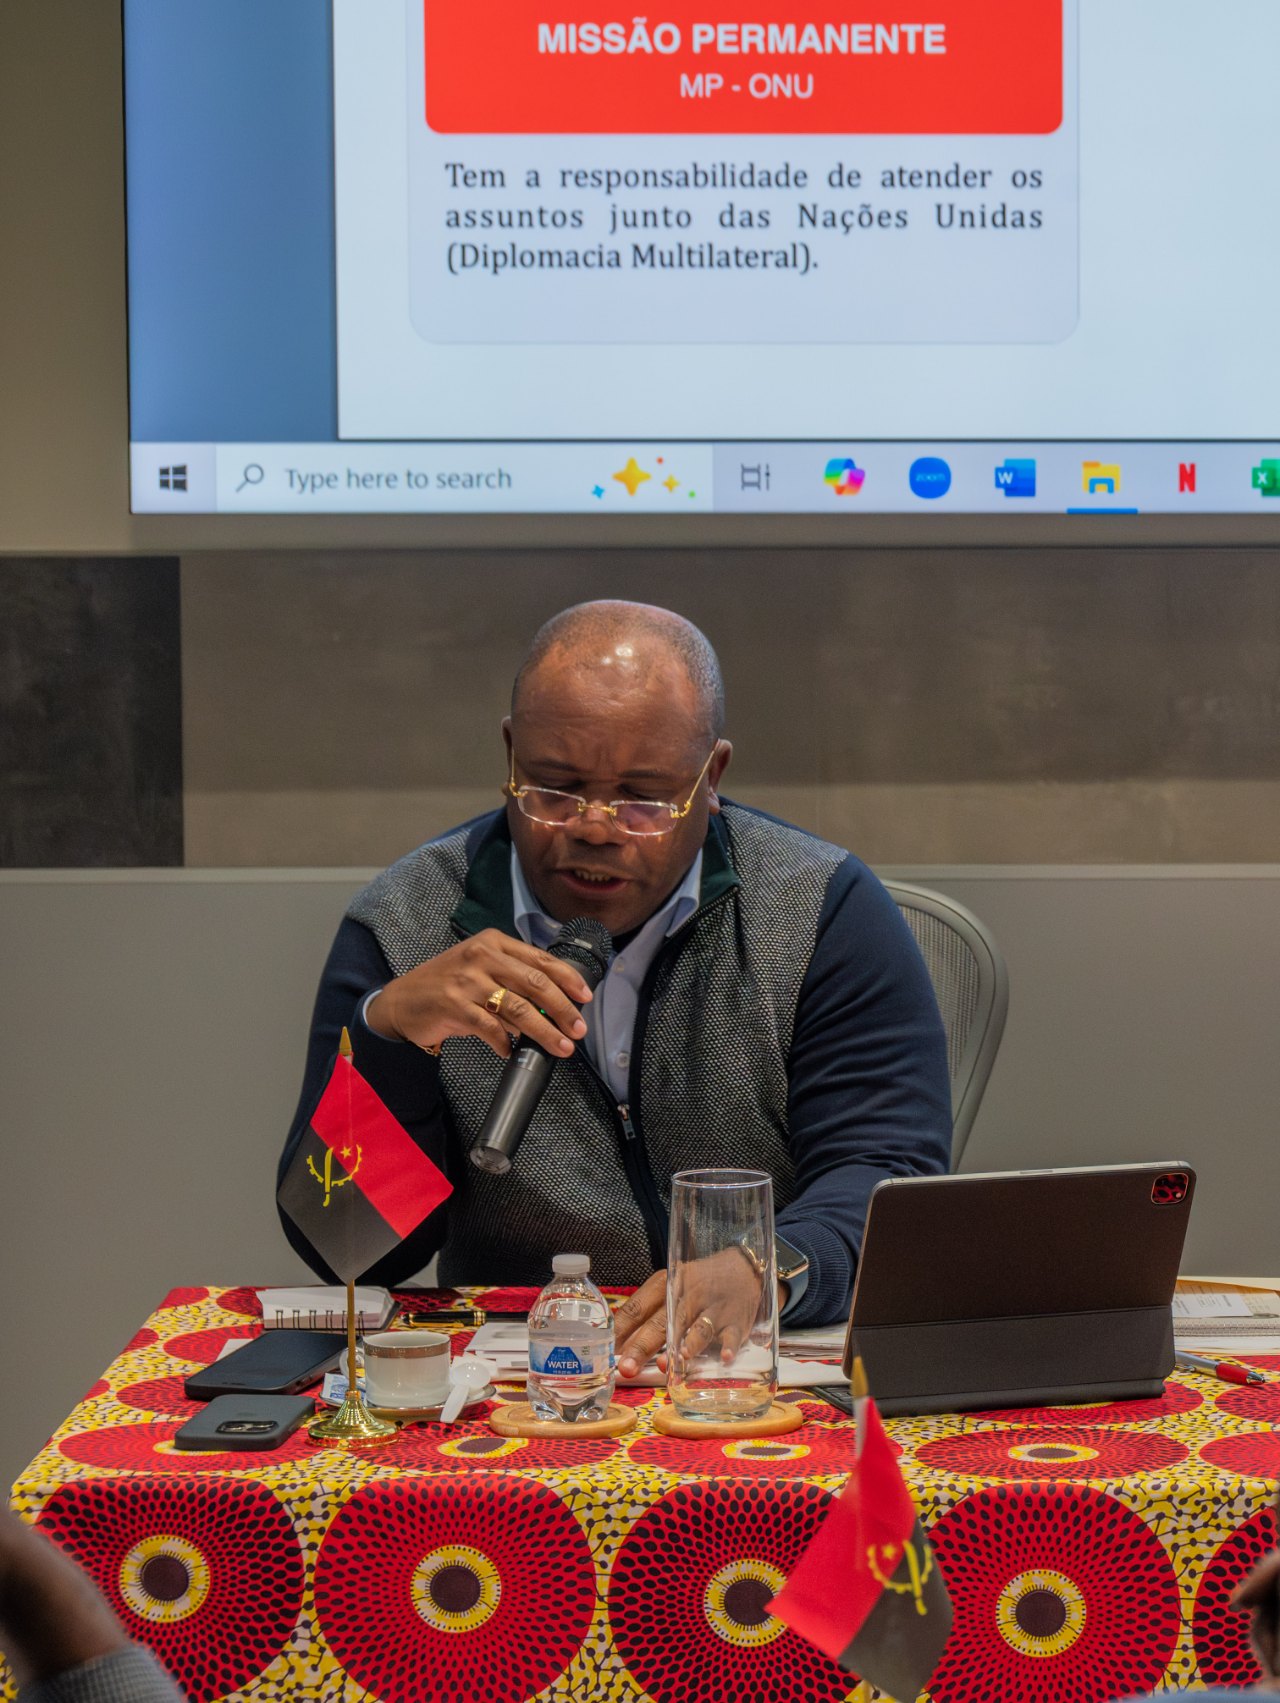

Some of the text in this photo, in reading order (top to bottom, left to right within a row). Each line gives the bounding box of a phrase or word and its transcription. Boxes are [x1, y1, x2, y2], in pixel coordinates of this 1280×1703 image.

[537, 16, 947, 55] MISSÃO PERMANENTE
[679, 72, 725, 99] MP
[748, 72, 815, 100] ONU
[444, 161, 1043, 196] Tem a responsabilidade de atender os
[445, 202, 1043, 235] assuntos junto das Nações Unidas
[447, 242, 819, 276] (Diplomacia Multilateral).
[286, 467, 513, 494] Type here to search
[997, 471, 1013, 485] W
[1179, 463, 1196, 493] N
[1257, 471, 1268, 485] X
[547, 1360, 579, 1369] WATER
